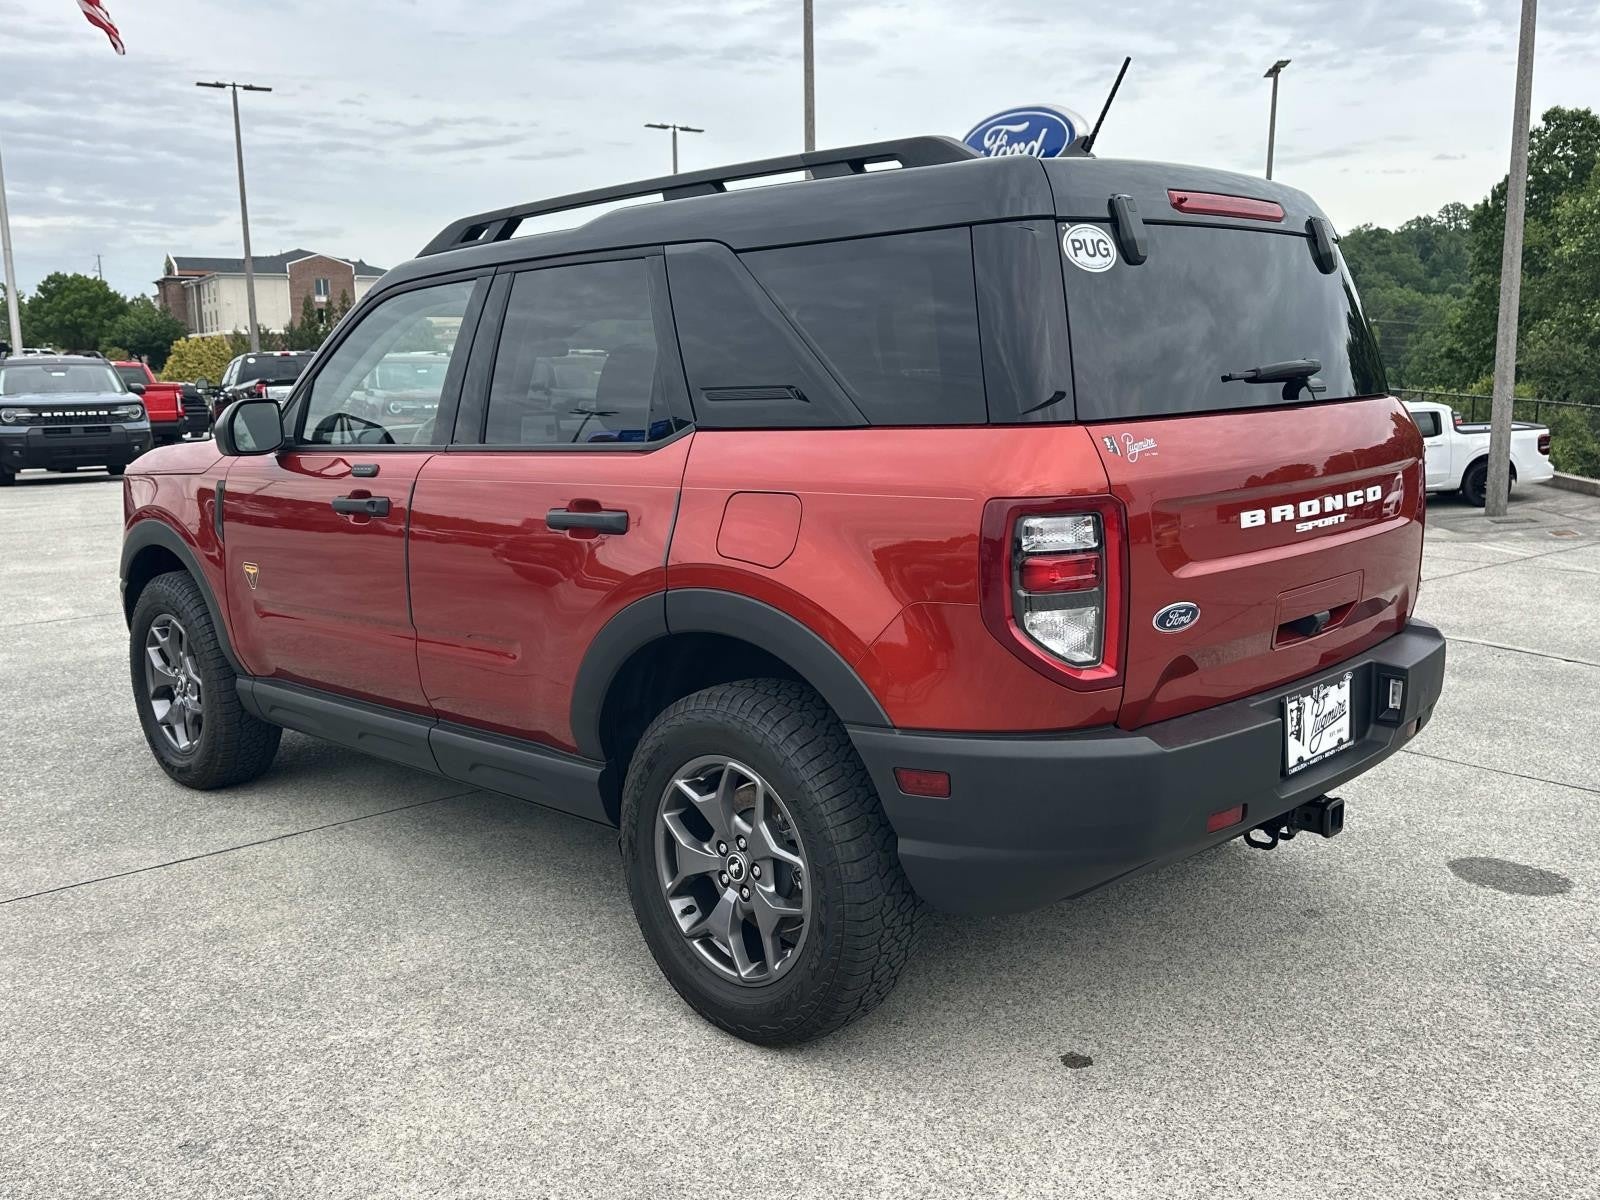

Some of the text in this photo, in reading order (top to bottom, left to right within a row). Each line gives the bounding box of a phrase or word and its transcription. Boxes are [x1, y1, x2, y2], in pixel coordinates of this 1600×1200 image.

[981, 120, 1048, 158] Ford
[1070, 238, 1111, 258] PUG
[1239, 485, 1382, 529] BRONCO
[1295, 513, 1347, 533] SPORT
[1165, 608, 1192, 627] Ford
